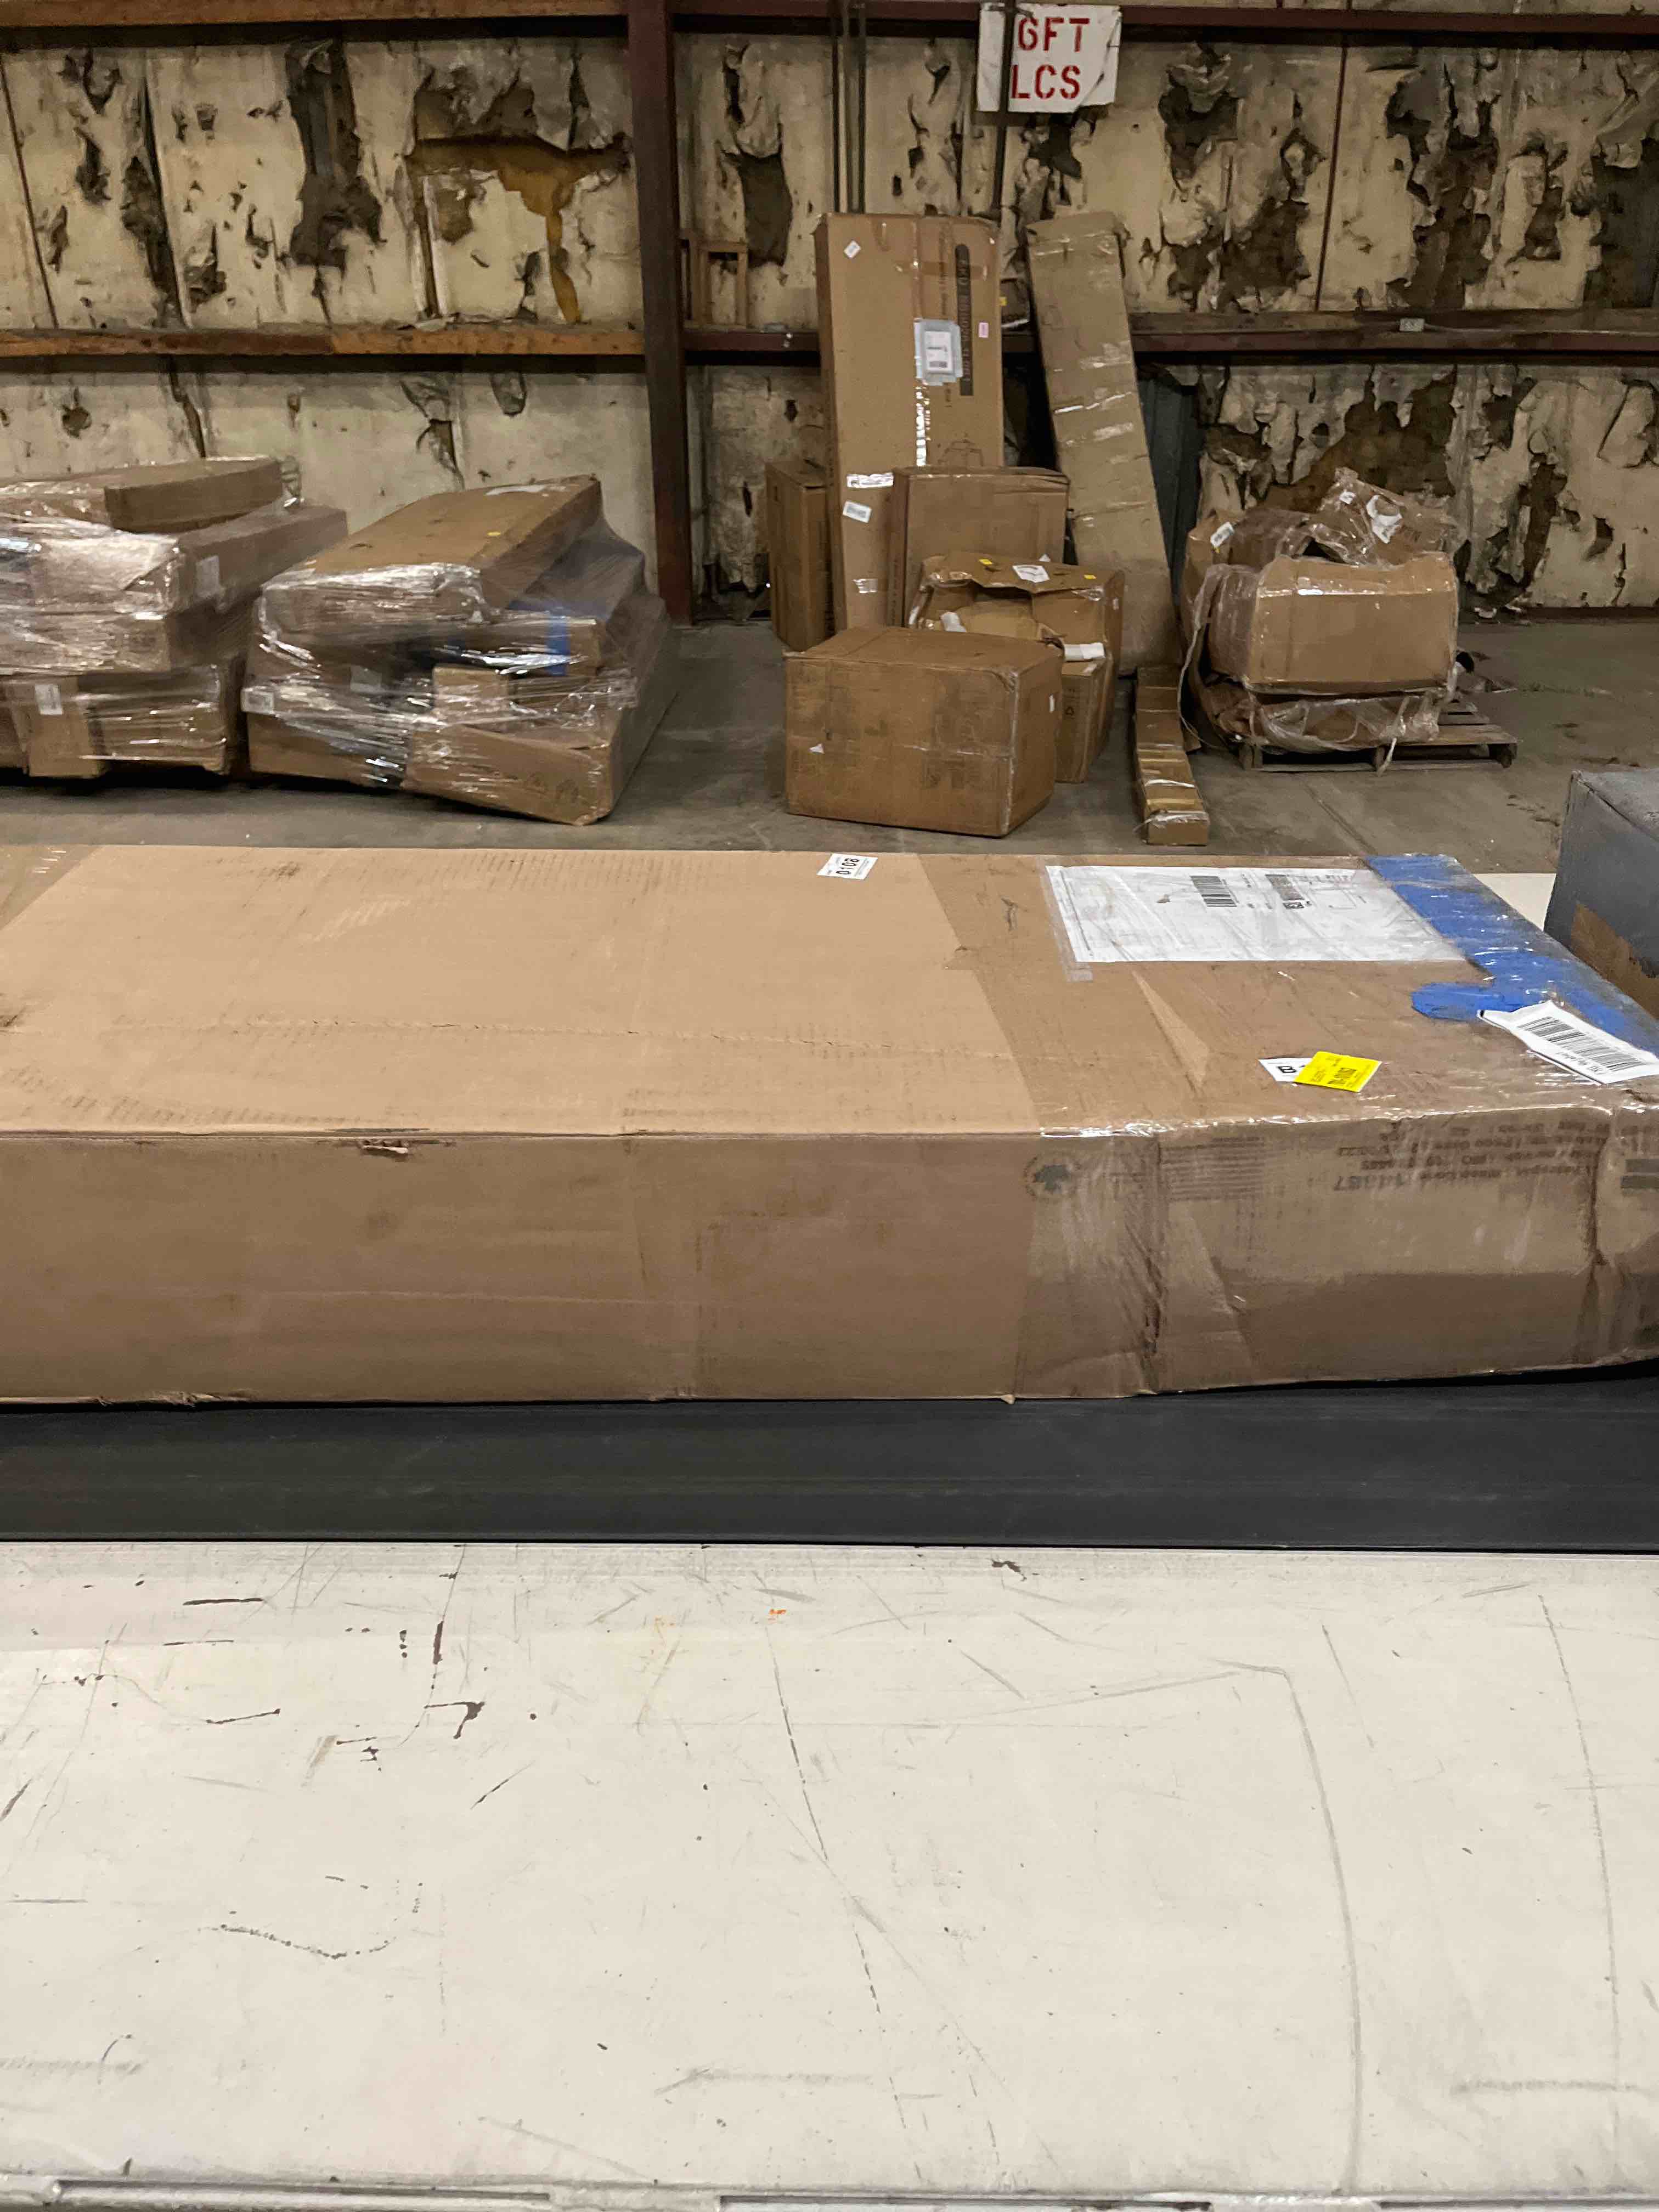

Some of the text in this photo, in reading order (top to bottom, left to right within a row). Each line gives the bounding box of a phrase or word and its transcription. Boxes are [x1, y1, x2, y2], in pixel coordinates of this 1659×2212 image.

[1017, 17, 1090, 52] 6FT
[1010, 64, 1081, 99] LCS
[836, 857, 860, 875] 0108
